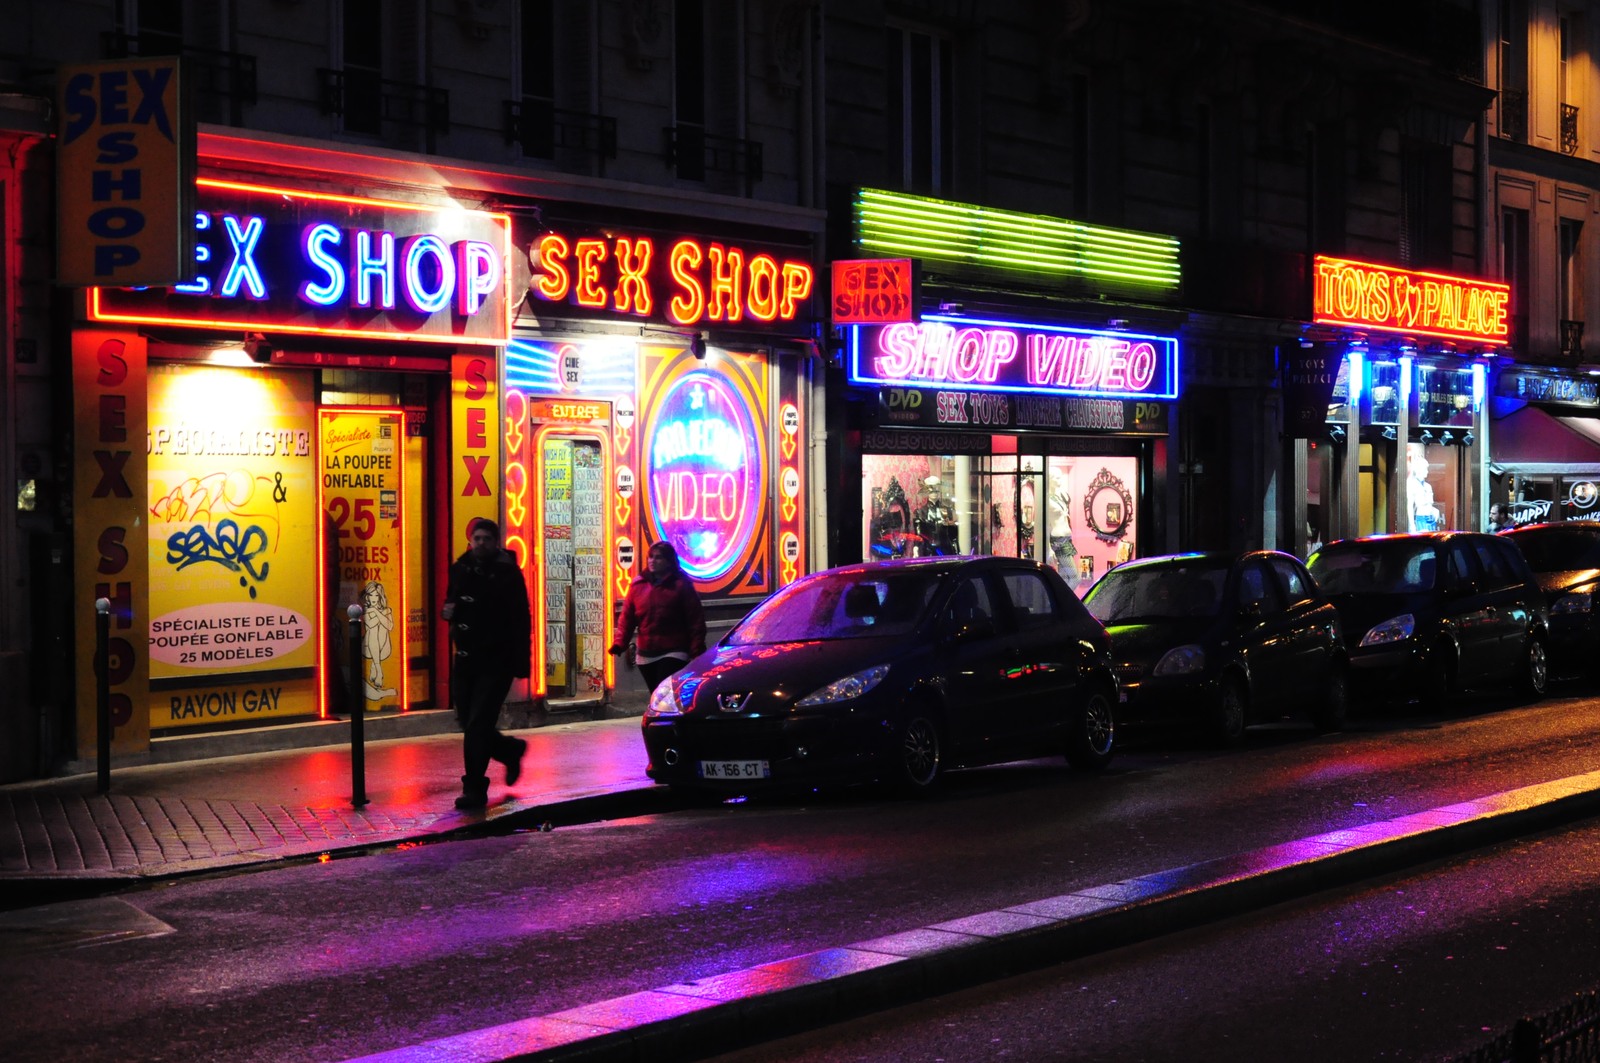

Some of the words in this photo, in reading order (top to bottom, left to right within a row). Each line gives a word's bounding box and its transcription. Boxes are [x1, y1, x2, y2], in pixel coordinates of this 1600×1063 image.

[64, 67, 175, 145] SEX
[87, 131, 145, 276] SHOP
[302, 222, 499, 316] SHOP
[534, 233, 653, 315] SEX
[668, 239, 813, 325] SHOP
[844, 265, 901, 291] SEX
[835, 293, 911, 318] SHOP
[1318, 263, 1391, 322] TOYS
[1423, 280, 1509, 335] PALACE
[874, 322, 1019, 383] SHOP
[1026, 332, 1158, 392] VIDEO
[566, 370, 580, 383] SEX
[889, 389, 922, 409] DVD
[936, 391, 968, 423] SEX
[969, 393, 1009, 425] TOYS
[1015, 394, 1062, 427] LINGERIE
[1065, 397, 1124, 430] CHAUSSURES
[1135, 402, 1160, 421] DVD
[92, 338, 134, 499] SEX
[461, 358, 492, 497] SEX
[326, 455, 341, 469] LA
[344, 455, 392, 469] POUPEE
[324, 473, 385, 489] ONFLABLE
[653, 471, 738, 522] VIDEO
[329, 496, 377, 541] 25
[1513, 502, 1552, 525] HAPPY
[338, 546, 389, 564] ODELES
[344, 567, 382, 581] CHOIX
[152, 617, 251, 632] SPÉCIALISTE
[255, 615, 275, 627] DE
[279, 614, 298, 625] LA
[213, 628, 304, 644] GONFLABLE
[180, 652, 197, 664] 25
[201, 646, 274, 662] MODÈLES
[170, 692, 237, 720] RAYON
[242, 687, 282, 713] GAY
[705, 762, 758, 777] AK-156-CT
